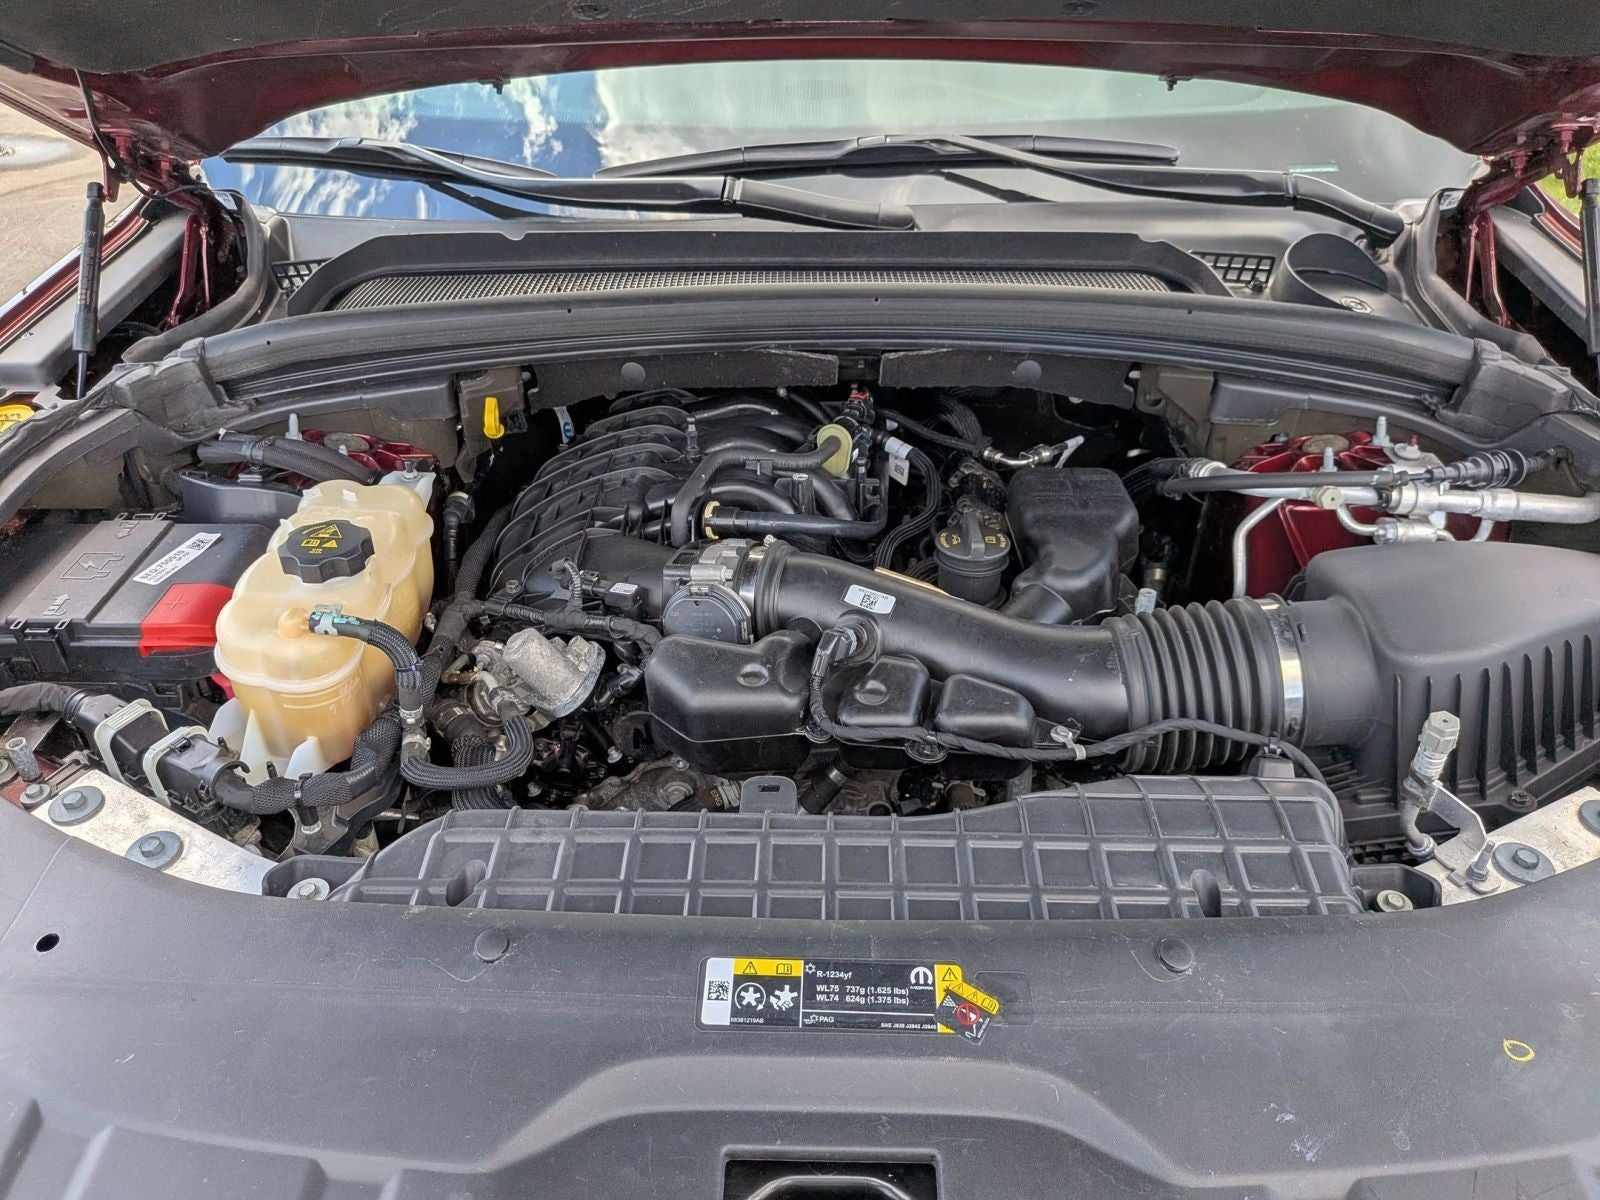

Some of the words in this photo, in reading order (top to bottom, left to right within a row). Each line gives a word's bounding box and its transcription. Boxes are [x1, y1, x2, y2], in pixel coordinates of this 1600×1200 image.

[816, 970, 853, 980] R-1234yf
[816, 984, 840, 992] WL75
[845, 985, 866, 995] 737g
[867, 986, 892, 995] (1.625
[893, 986, 909, 996] lbs)
[816, 994, 840, 1002] WL74
[845, 995, 866, 1004] 624g
[867, 996, 892, 1005] (1.375
[893, 996, 910, 1006] lbs)
